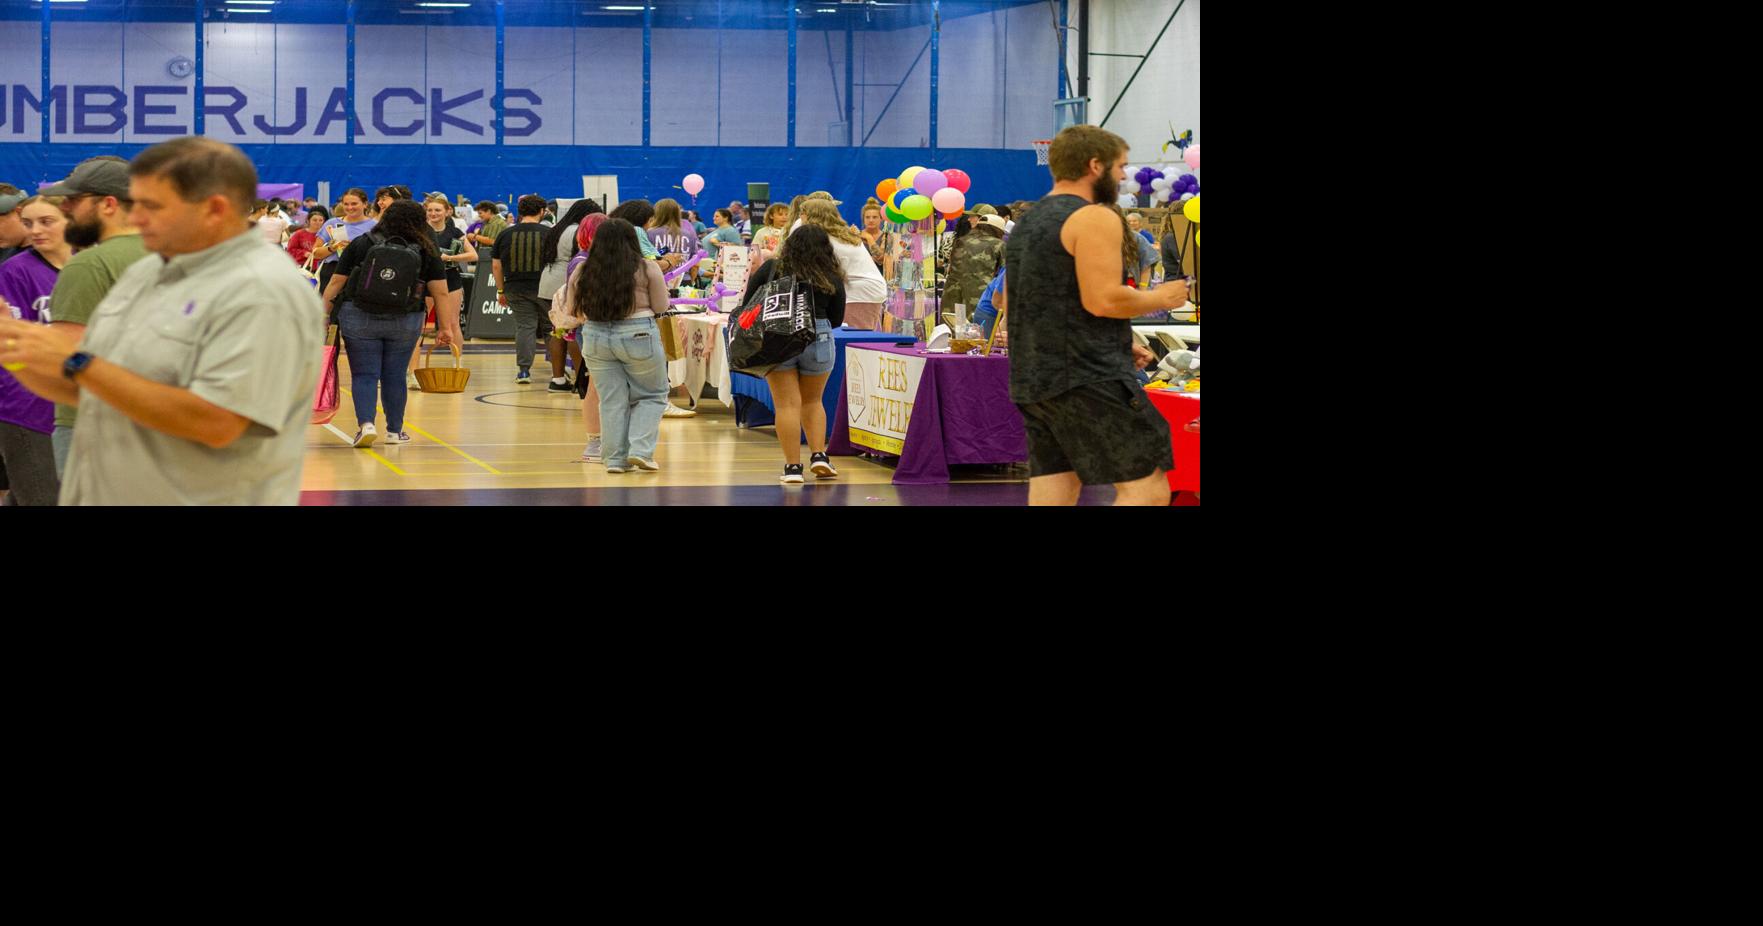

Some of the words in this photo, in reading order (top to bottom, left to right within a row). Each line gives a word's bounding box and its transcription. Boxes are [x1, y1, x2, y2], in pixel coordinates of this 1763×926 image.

[0, 84, 543, 138] MBERJACKS
[654, 234, 690, 253] NMC
[481, 300, 513, 315] CAMPU
[877, 356, 908, 393] REES
[867, 395, 914, 434] JEWELR
